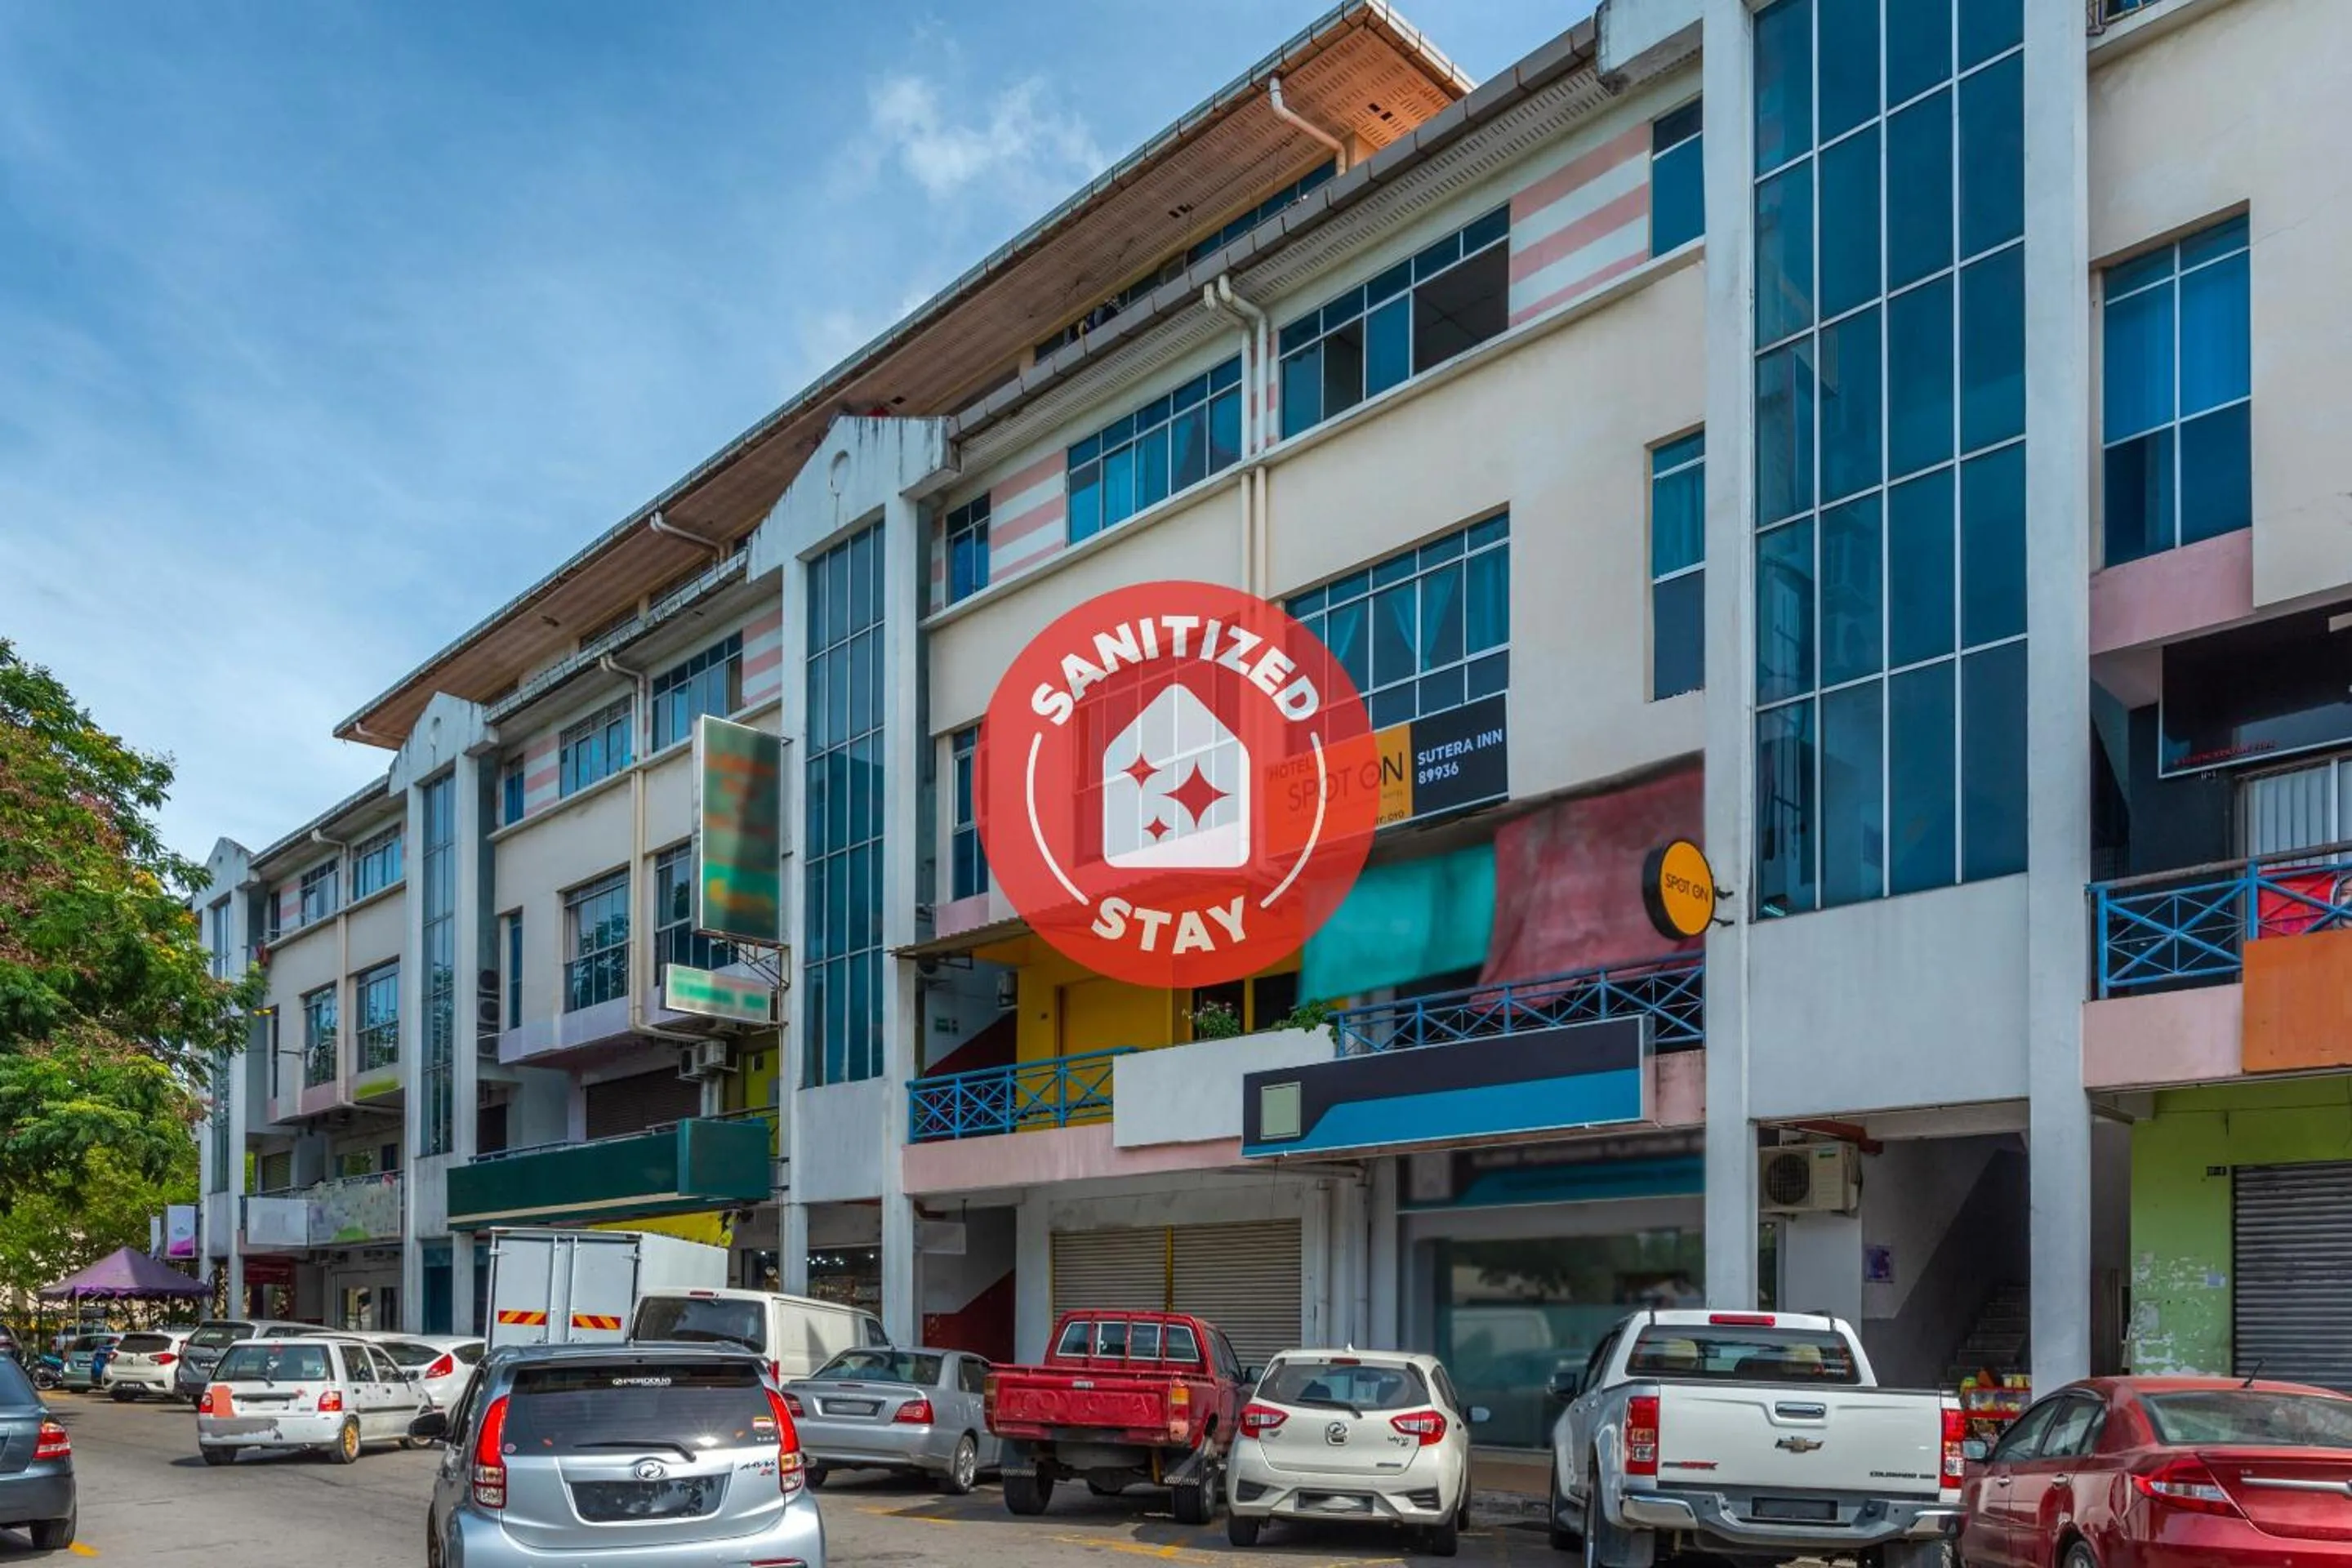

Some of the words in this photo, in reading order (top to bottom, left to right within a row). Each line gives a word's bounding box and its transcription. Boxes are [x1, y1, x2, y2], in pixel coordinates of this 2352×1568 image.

[1417, 738, 1473, 766] SUTERA
[1477, 728, 1503, 749] INN
[1268, 758, 1315, 782] HOTEL
[1359, 751, 1403, 791] ON
[1418, 761, 1459, 785] 89936
[1665, 871, 1690, 896] SPOT
[1691, 884, 1709, 903] ON
